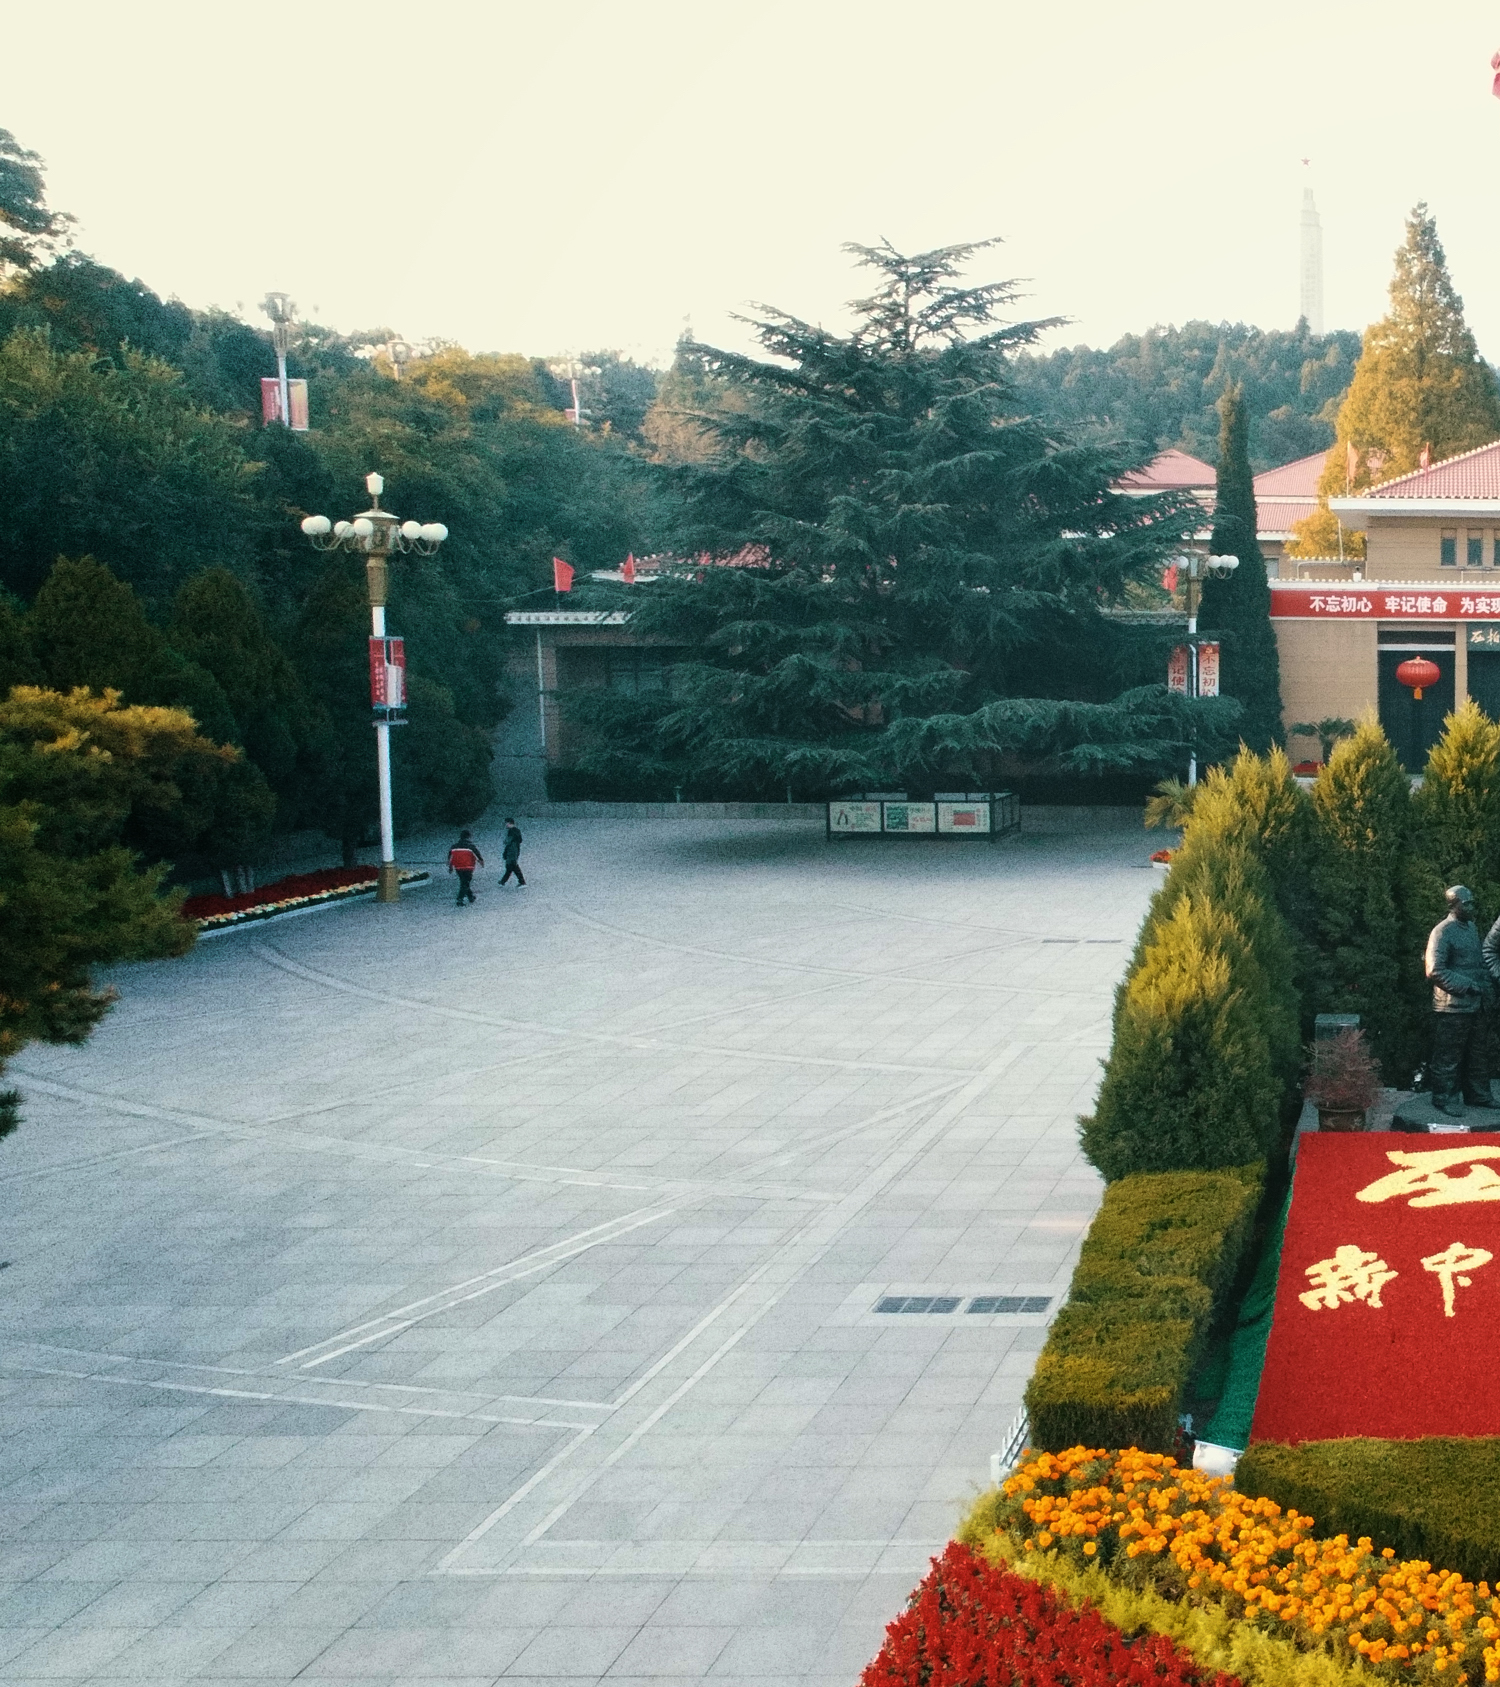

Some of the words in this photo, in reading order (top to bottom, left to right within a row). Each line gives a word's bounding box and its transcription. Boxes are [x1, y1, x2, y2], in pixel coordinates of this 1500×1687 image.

[1309, 595, 1373, 613] 不忘初心
[1385, 595, 1448, 614] 牢记使命
